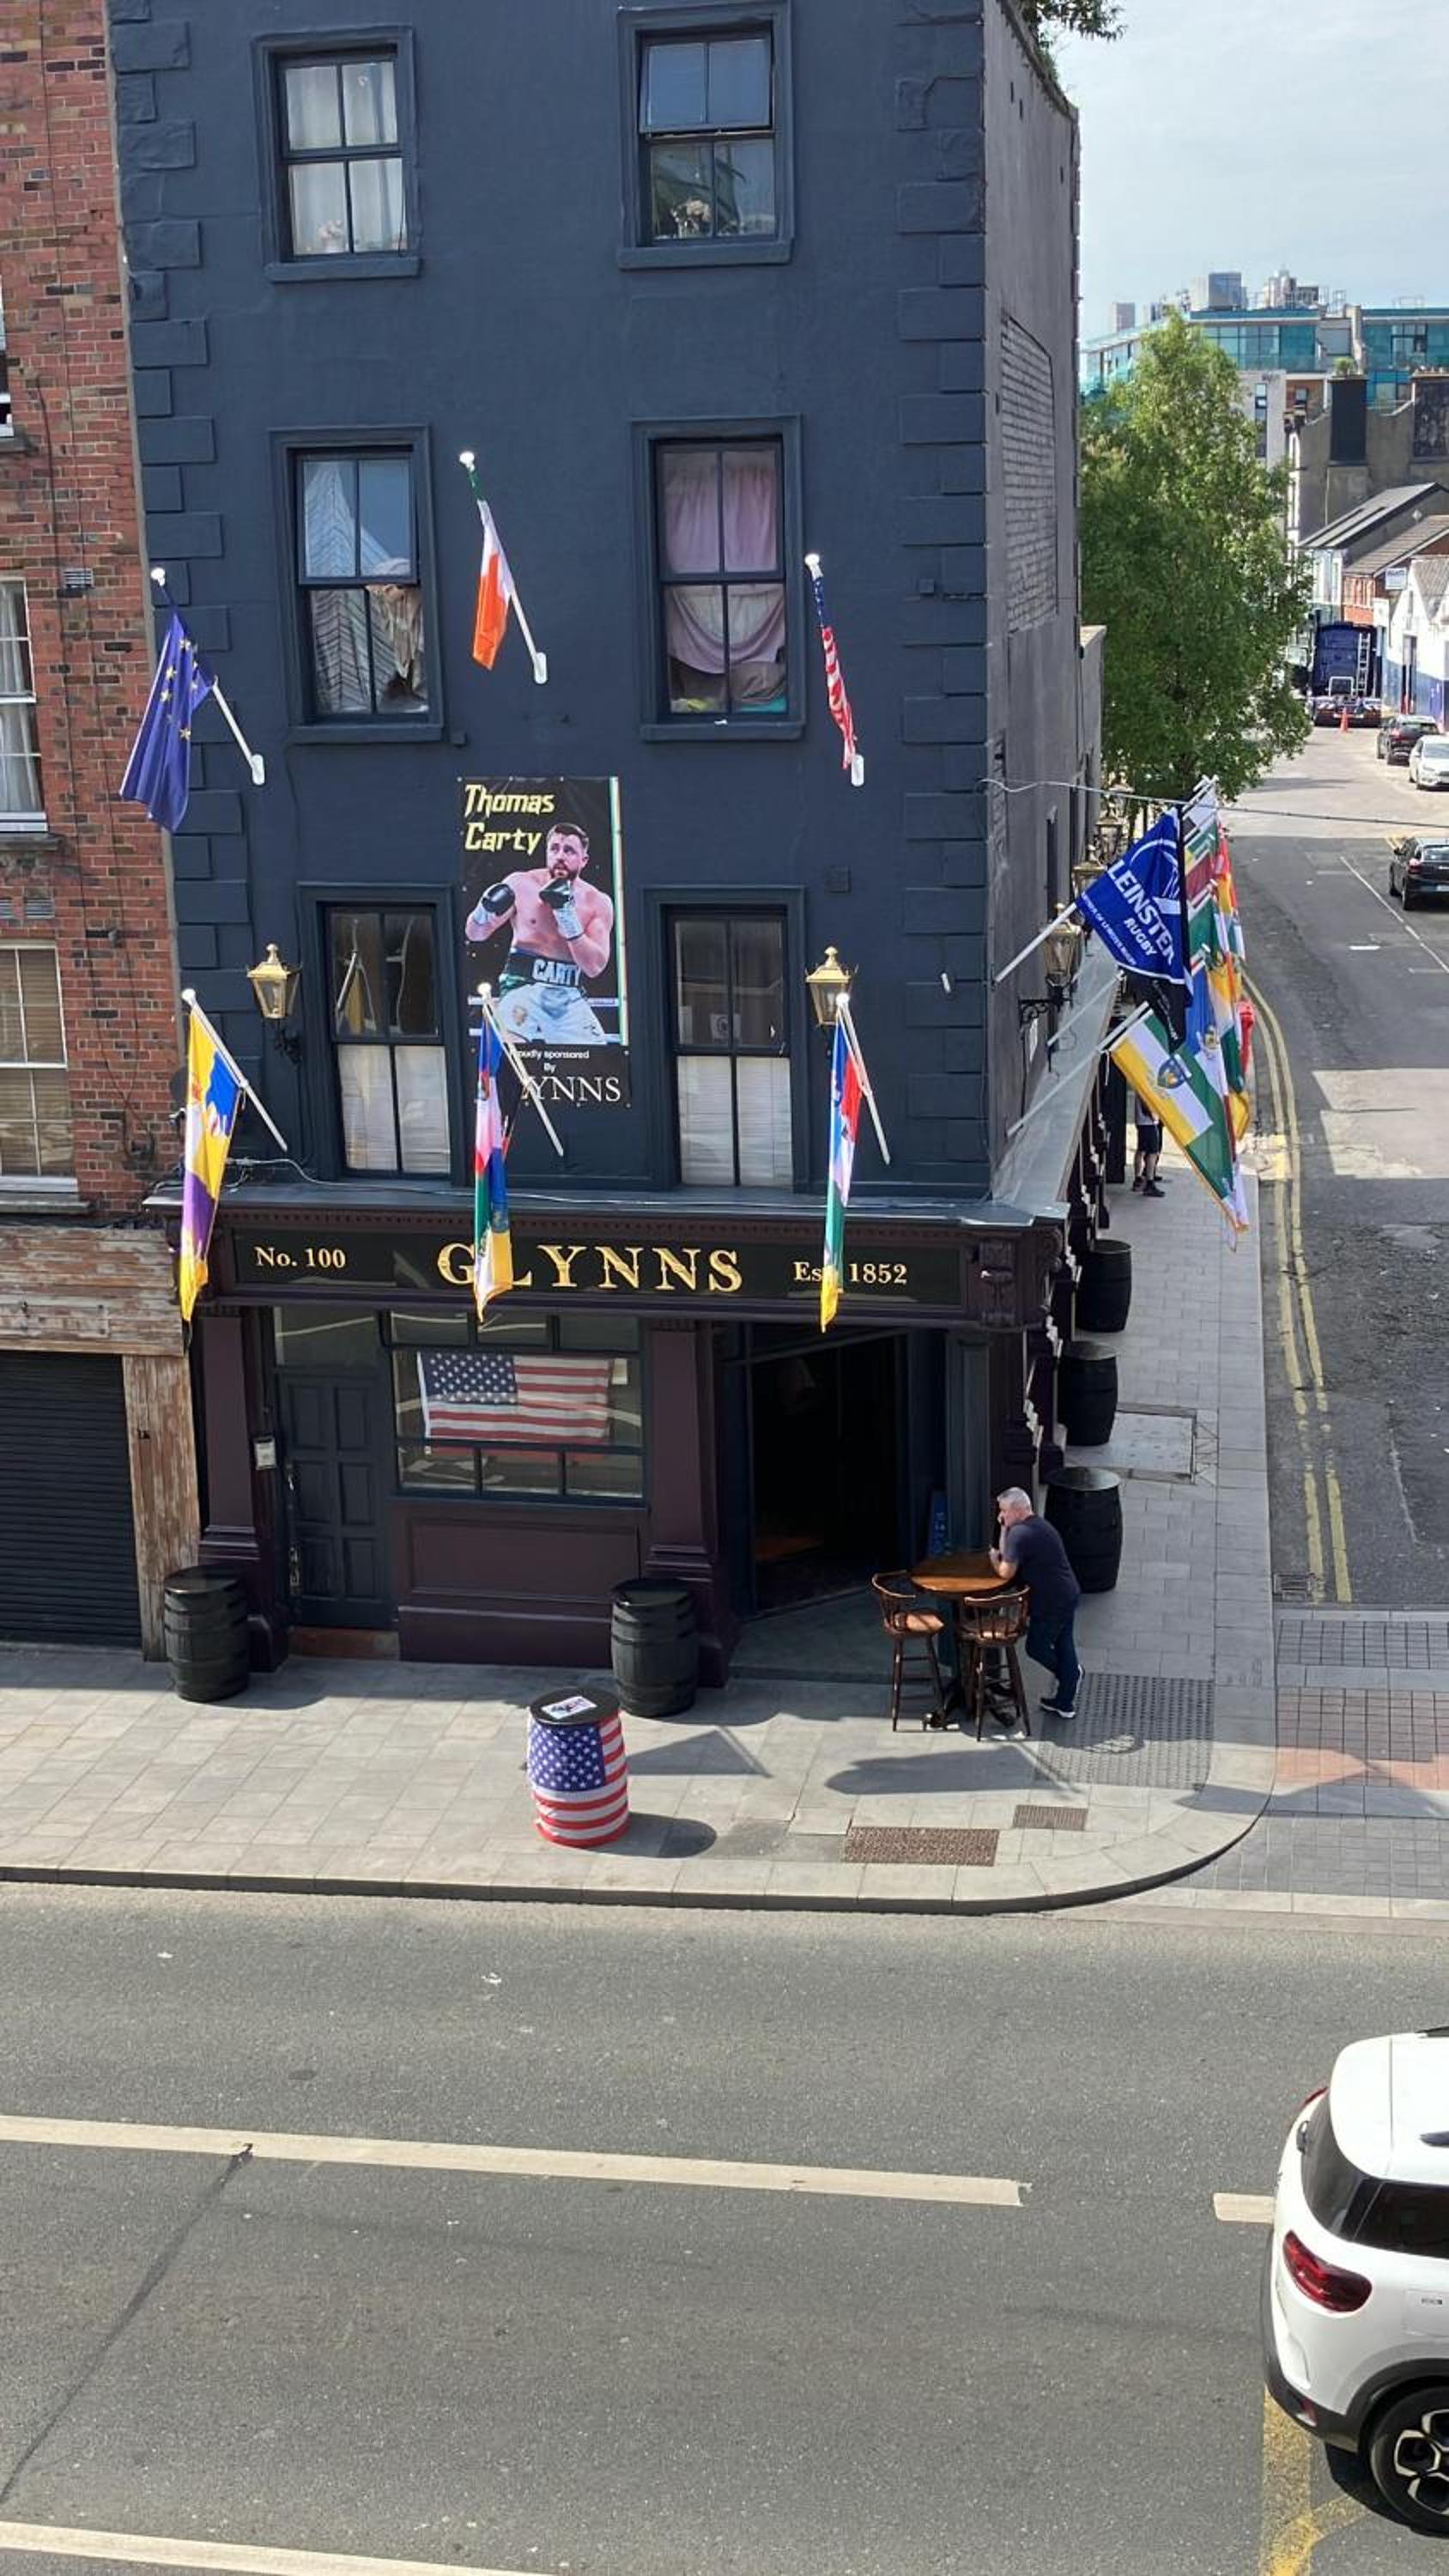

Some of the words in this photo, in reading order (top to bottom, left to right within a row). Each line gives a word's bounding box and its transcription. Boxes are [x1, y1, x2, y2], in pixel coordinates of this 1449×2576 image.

[464, 784, 555, 818] Thomas
[464, 822, 543, 857] Carty
[1106, 859, 1174, 965] LEINSTER
[1124, 917, 1157, 957] RUGBY
[532, 958, 580, 987] CARTY
[513, 1048, 543, 1061] oudly
[543, 1049, 590, 1060] sponsored
[543, 1061, 556, 1073] By
[521, 1075, 621, 1103] YNNS
[255, 1246, 298, 1267] No.
[305, 1248, 347, 1269] 100
[848, 1262, 908, 1285] 1852
